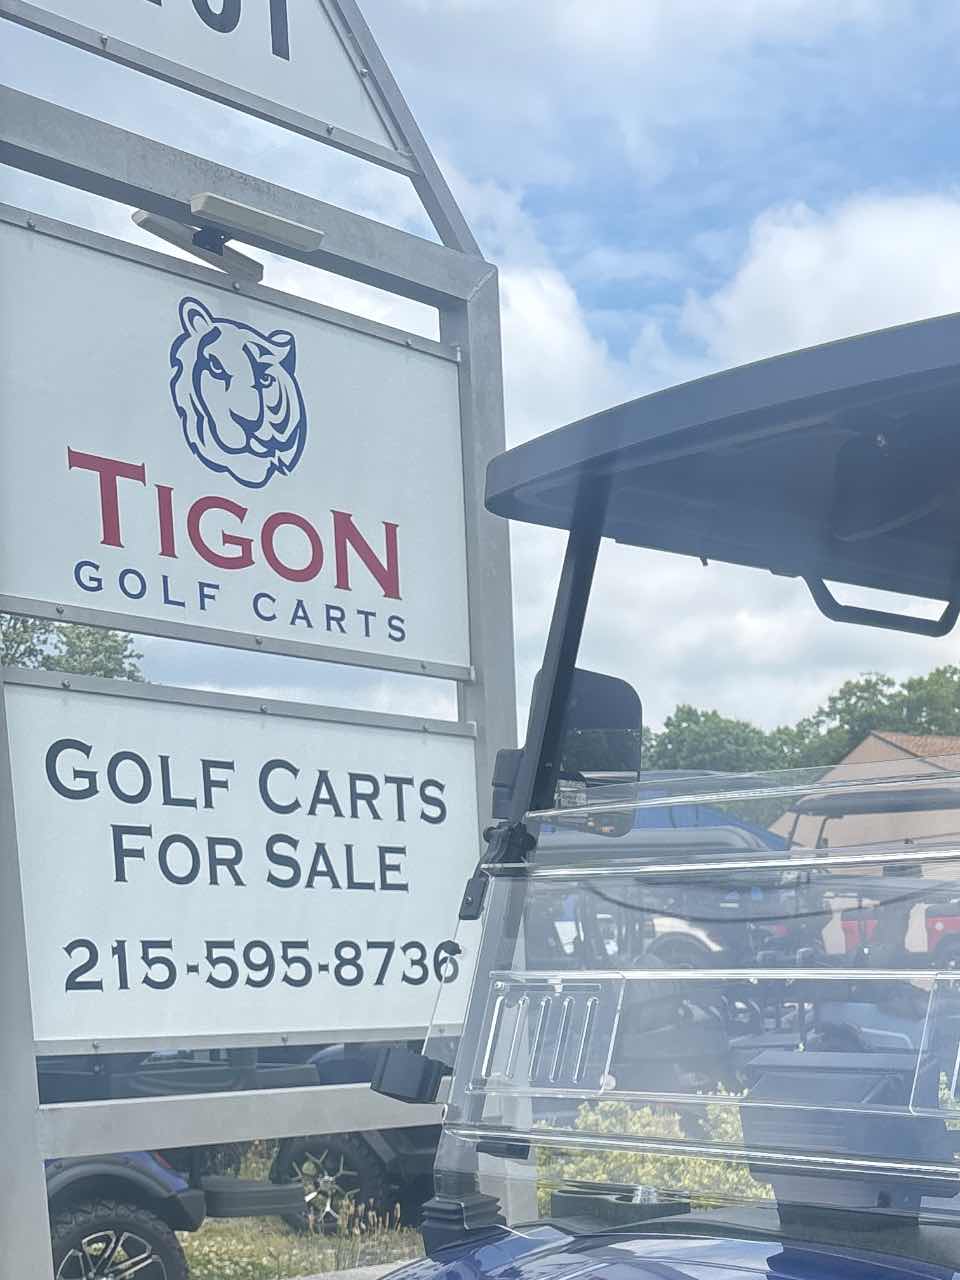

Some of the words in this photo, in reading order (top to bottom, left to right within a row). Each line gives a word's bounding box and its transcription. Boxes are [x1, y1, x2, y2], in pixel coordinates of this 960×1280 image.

[67, 446, 402, 600] TIGON
[74, 560, 220, 610] GOLF
[253, 593, 406, 641] CARTS
[45, 738, 235, 811] GOLF
[258, 758, 448, 825] CARTS
[110, 824, 246, 887] FOR
[265, 834, 409, 892] SALE
[63, 938, 460, 992] 215-595-8736
